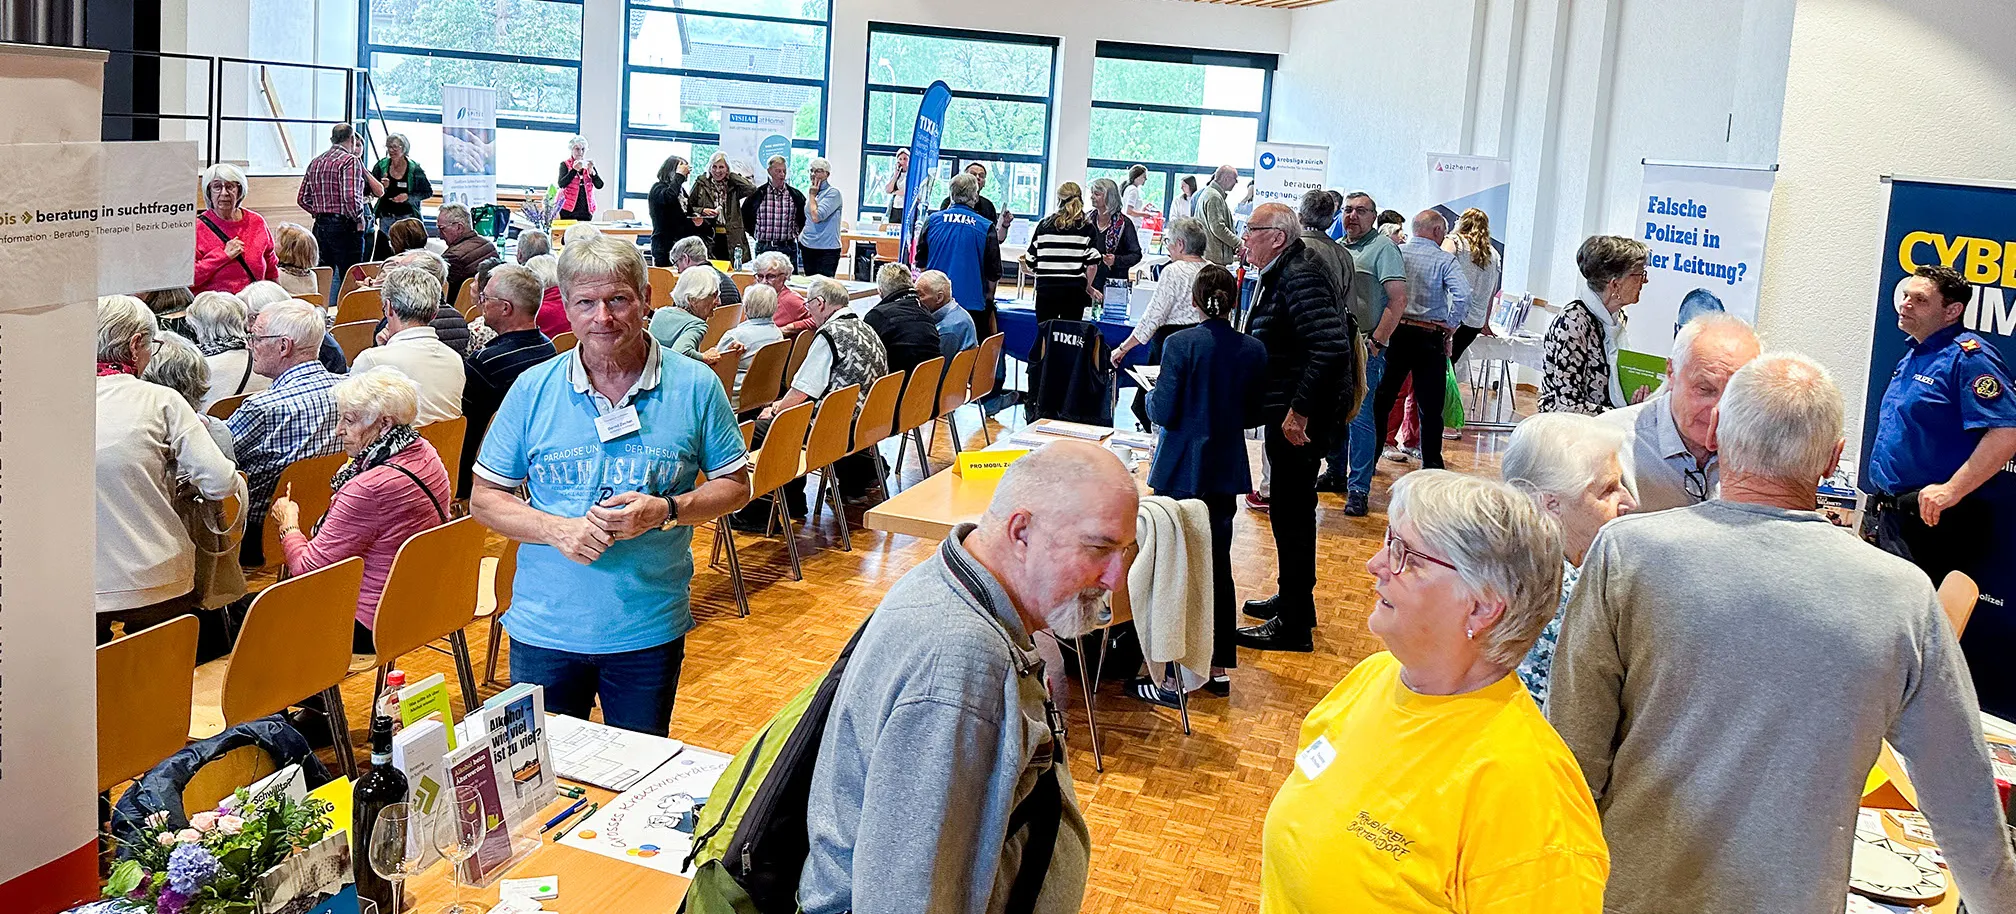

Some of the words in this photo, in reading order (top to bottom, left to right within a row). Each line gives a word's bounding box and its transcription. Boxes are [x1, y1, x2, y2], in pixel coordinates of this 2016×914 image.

[731, 114, 757, 122] VISILAB
[920, 115, 936, 135] TIXI
[1444, 163, 1479, 171] alzheimer
[1255, 189, 1303, 200] begegnungs
[1283, 179, 1322, 190] beratung
[36, 207, 99, 223] beratung
[101, 205, 115, 217] in
[117, 201, 194, 216] suchtfragen
[1647, 195, 1707, 219] Falsche
[943, 213, 966, 224] TIXI
[0, 232, 47, 244] nformation
[53, 229, 90, 240] Beratung
[96, 225, 130, 236] Therapie
[136, 222, 160, 232] Bezirk
[161, 220, 193, 230] Dietikon
[1644, 222, 1698, 246] Polizei
[1702, 229, 1720, 249] in
[1673, 252, 1747, 285] Leitung?
[1052, 331, 1077, 345] TIXI
[1912, 373, 1935, 386] POLIZEI
[543, 447, 584, 462] PARADISE
[644, 446, 661, 456] THE
[662, 449, 679, 459] SUN
[534, 458, 593, 485] PALM
[1979, 594, 2004, 607] olizei
[490, 705, 525, 732] Alkohol
[492, 731, 509, 749] wie
[510, 719, 527, 739] viel
[493, 747, 506, 764] ist
[507, 742, 518, 757] zu
[520, 727, 542, 749] viel?
[454, 761, 473, 777] Alkohol
[606, 812, 627, 848] Grosses
